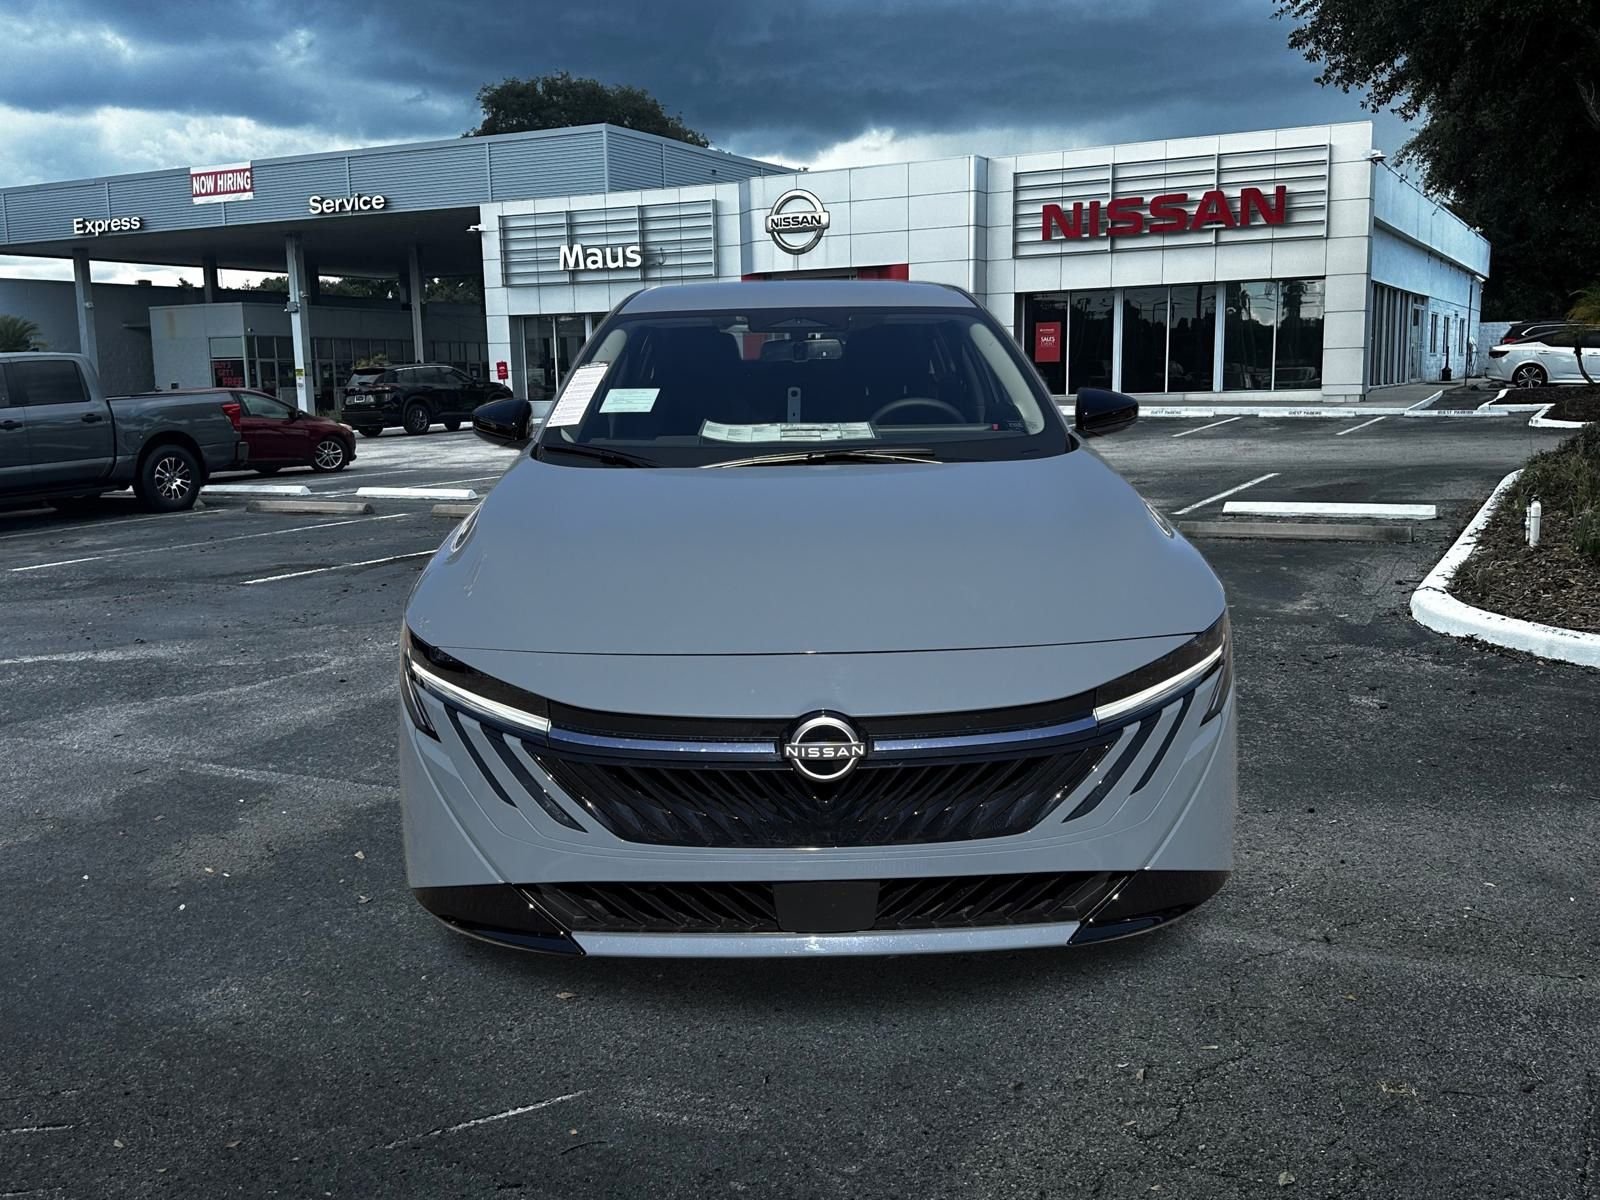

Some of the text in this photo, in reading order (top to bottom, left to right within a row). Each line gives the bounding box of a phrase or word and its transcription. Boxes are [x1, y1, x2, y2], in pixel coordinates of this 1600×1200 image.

[193, 171, 251, 195] NOW HIRING
[309, 193, 385, 214] Service
[1042, 185, 1287, 240] NISSAN
[73, 217, 141, 236] Express
[771, 215, 822, 228] NISSAN
[560, 244, 642, 270] Maus
[786, 745, 864, 757] NISSAN
